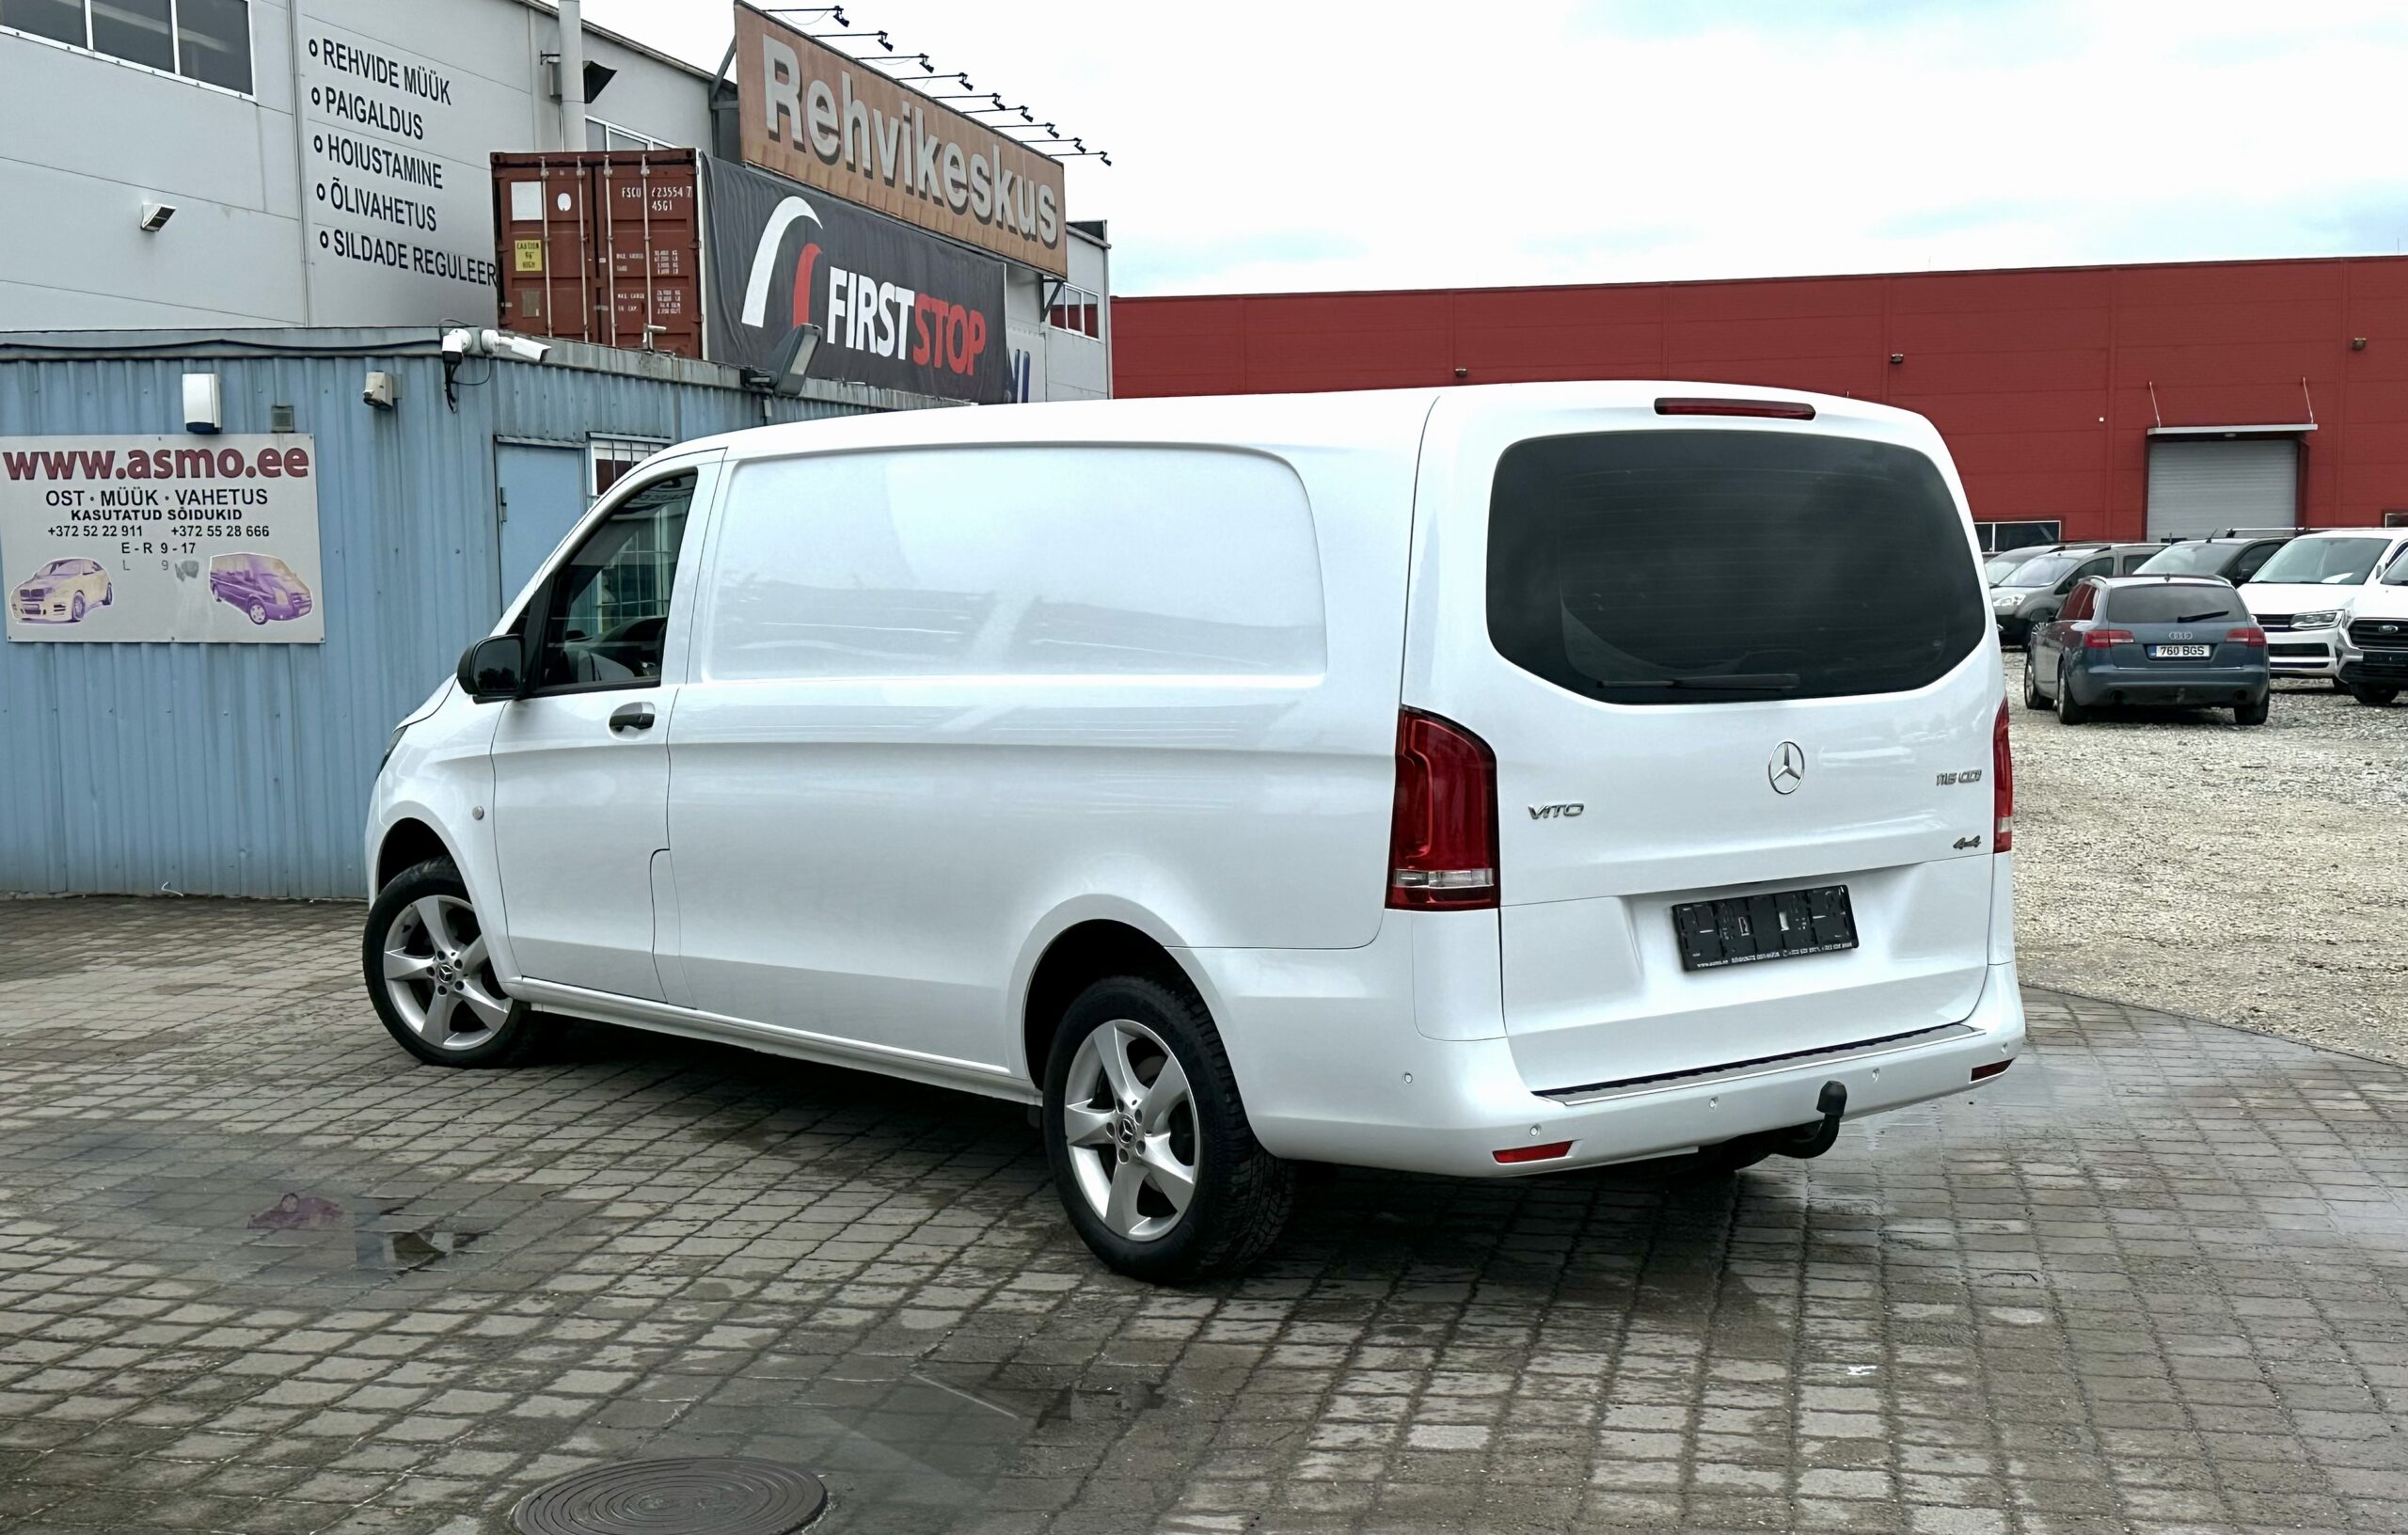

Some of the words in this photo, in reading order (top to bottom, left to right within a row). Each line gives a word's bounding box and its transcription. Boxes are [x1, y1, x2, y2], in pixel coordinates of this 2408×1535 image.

[323, 38, 400, 88] REHVIDE
[404, 65, 452, 105] MÜÜK
[325, 87, 423, 140] PAIGALDUS
[762, 33, 1059, 249] Rehvikeskus
[328, 134, 443, 189] HOIUSTAMINE
[330, 177, 436, 231] ÕLIVAHETUS
[622, 187, 642, 198] FSCU
[334, 229, 408, 270] SILDADE
[414, 246, 497, 288] REGULEER
[827, 266, 987, 376] FIRSTSTOP
[2, 447, 309, 480] www.asmo.ee
[45, 490, 86, 506] OST
[100, 486, 159, 506] MÜÜK
[175, 488, 268, 505] VAHETUS
[71, 509, 163, 521] KASUTATUD
[167, 506, 243, 521] SÕIDUKID
[48, 525, 79, 537] +372
[83, 525, 99, 537] 52
[102, 525, 118, 537] 22
[121, 525, 143, 537] 911
[171, 525, 203, 537] +372
[207, 525, 223, 537] 55
[226, 525, 242, 537] 28
[246, 525, 270, 537] 666
[2160, 645, 2179, 656] 760
[2182, 645, 2205, 656] BGS
[1528, 803, 1584, 820] VITO
